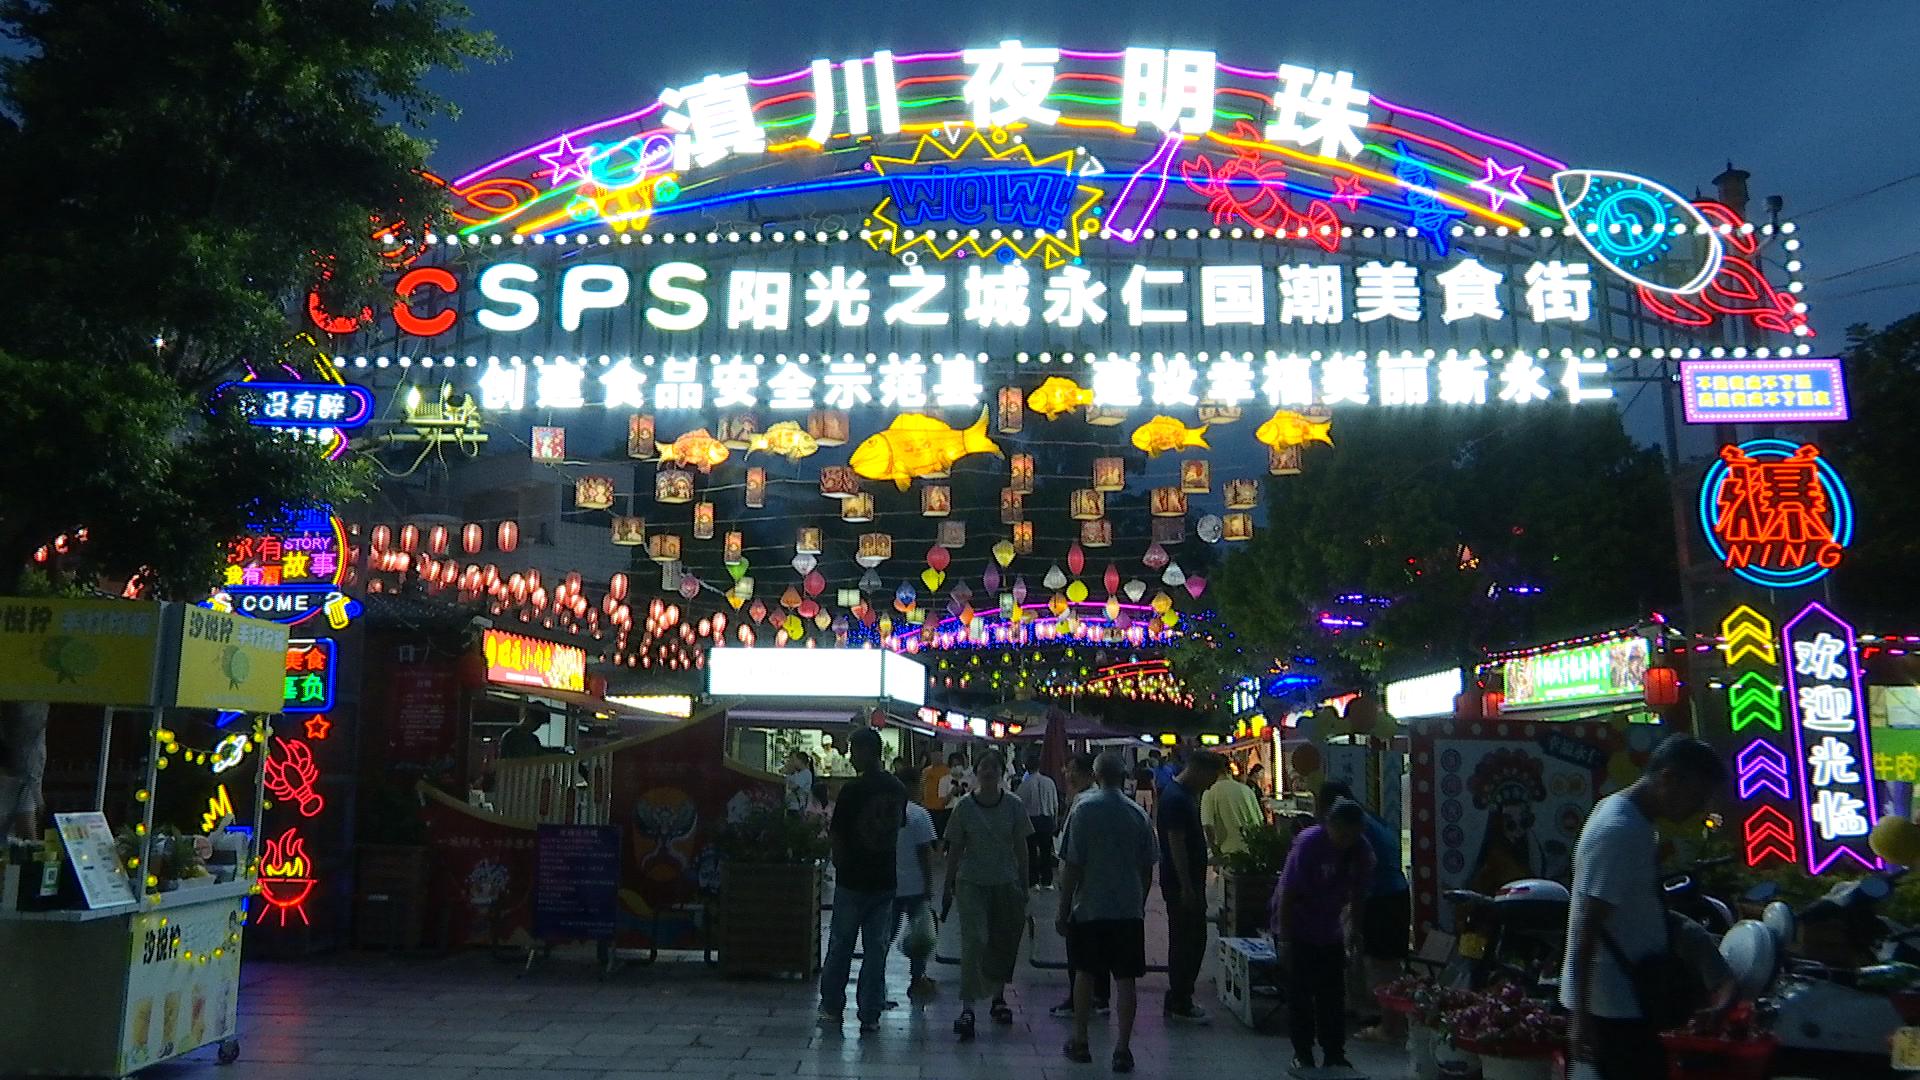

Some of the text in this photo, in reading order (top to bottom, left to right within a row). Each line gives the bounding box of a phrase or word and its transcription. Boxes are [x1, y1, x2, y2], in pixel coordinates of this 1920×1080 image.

[660, 39, 1370, 170] 滇川夜明珠
[889, 166, 1075, 232] WOW!
[727, 258, 1592, 330] 阳光之城永仁国潮美食街
[479, 351, 1614, 409] 创建食品安全示范县 建设幸福美丽新永仁
[282, 551, 337, 579] 故事
[284, 536, 332, 551] STORY
[1727, 543, 1843, 568] NING
[1792, 632, 1870, 840] 欢迎光临
